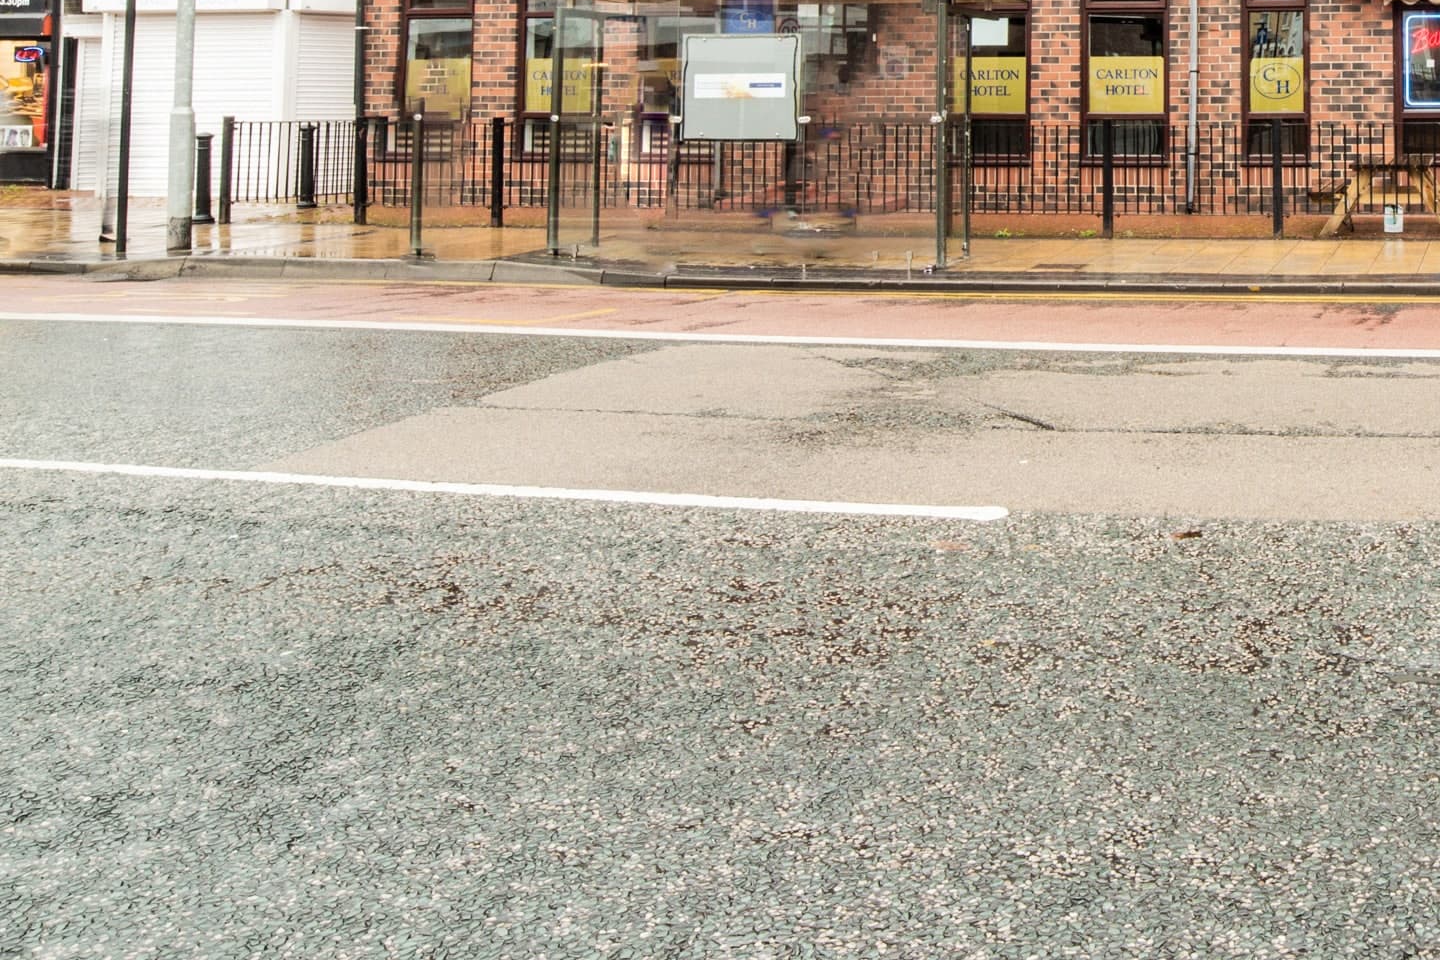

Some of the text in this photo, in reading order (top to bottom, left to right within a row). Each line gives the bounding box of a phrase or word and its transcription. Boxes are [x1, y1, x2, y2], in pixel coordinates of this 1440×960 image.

[532, 70, 587, 81] CATON
[1096, 68, 1158, 80] CARLTON
[1105, 84, 1151, 96] HOTEL
